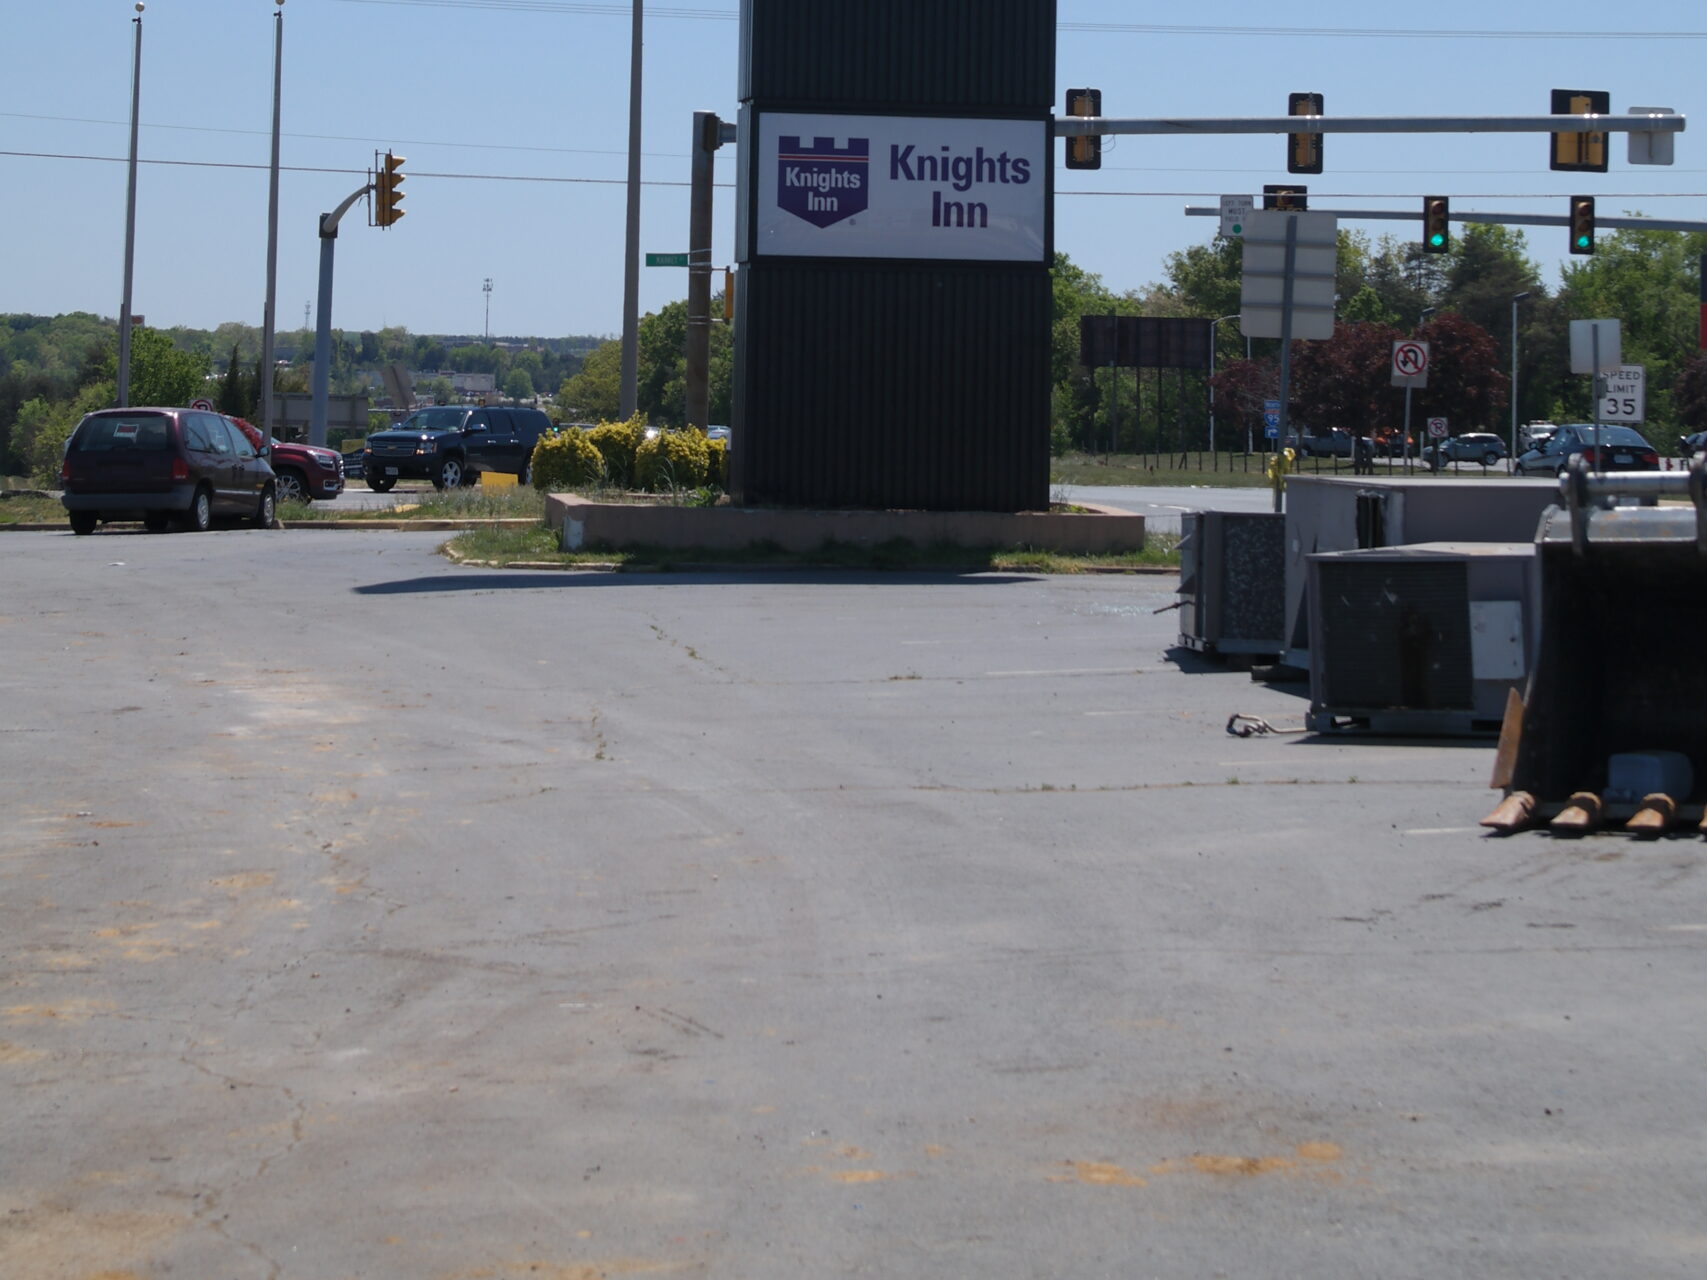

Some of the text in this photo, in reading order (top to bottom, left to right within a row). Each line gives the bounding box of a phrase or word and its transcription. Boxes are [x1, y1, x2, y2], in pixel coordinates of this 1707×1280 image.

[889, 144, 1031, 192] Knights
[785, 167, 861, 192] Knights
[807, 191, 839, 213] Inn
[932, 191, 988, 228] Inn
[1228, 207, 1246, 215] MUST
[1601, 370, 1640, 380] SPEED
[1606, 384, 1636, 393] LIMIT
[1606, 398, 1636, 416] 35
[1267, 414, 1280, 423] 95
